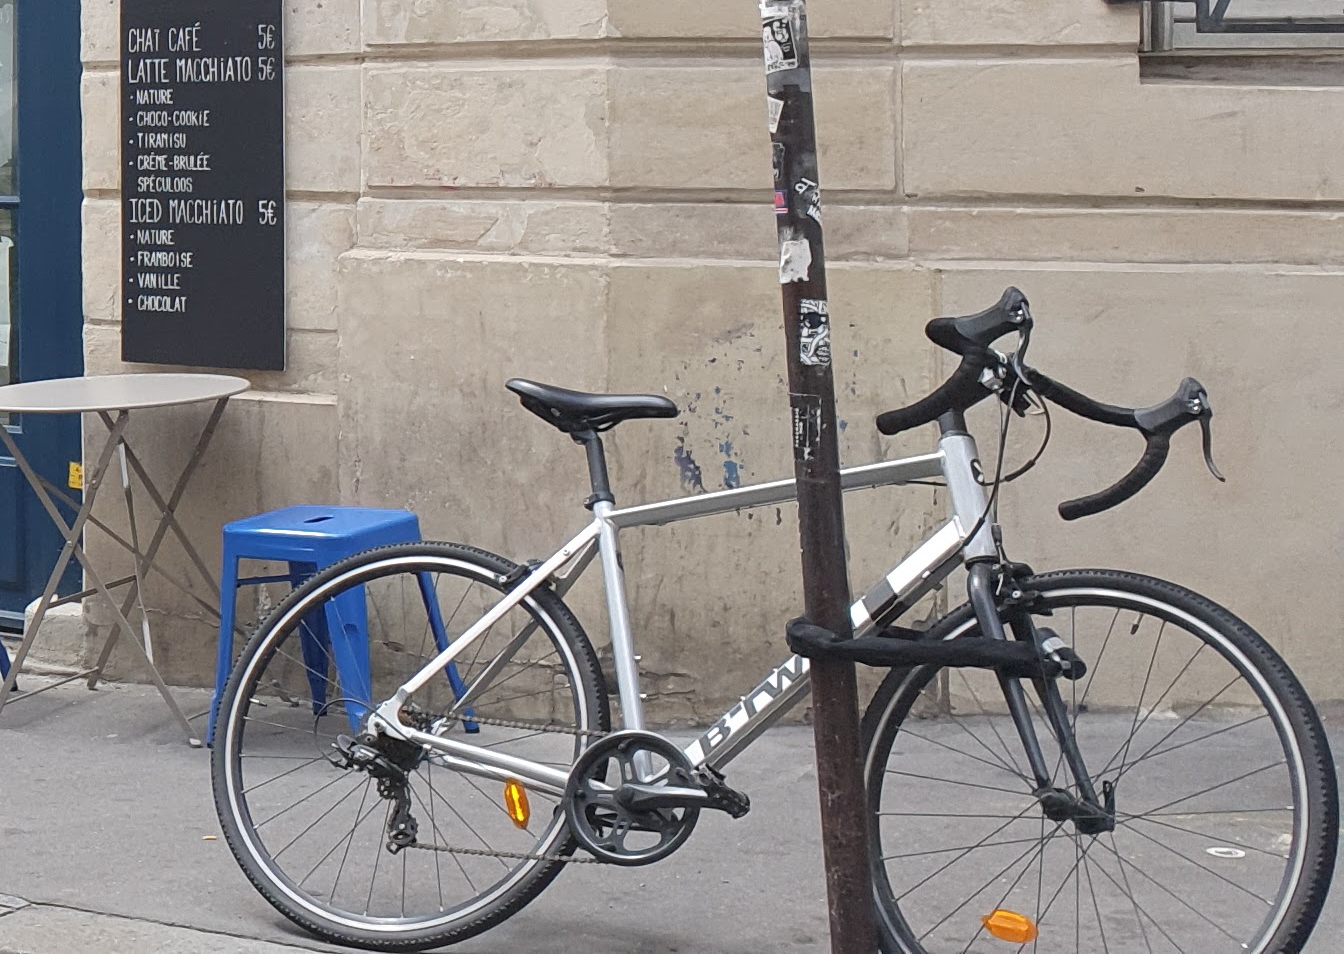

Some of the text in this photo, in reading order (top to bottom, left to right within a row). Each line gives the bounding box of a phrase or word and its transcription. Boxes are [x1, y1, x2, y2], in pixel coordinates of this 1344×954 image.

[168, 21, 202, 52] CAFÉ
[258, 24, 275, 51] 5€
[128, 56, 275, 84] LATTE MACCHIATO 5€
[136, 89, 173, 105] NATURE
[136, 110, 210, 127] CHOCO-COOKIE
[137, 132, 186, 149] TIRAMISU
[137, 174, 193, 193] SPÉCULOOS
[129, 198, 277, 226] ICED MACCHIATO 5€
[137, 229, 175, 245] NATURE
[137, 251, 194, 268] FRAMBOISE
[138, 273, 182, 290] VANILLE
[137, 295, 186, 312] CHOCOLAT
